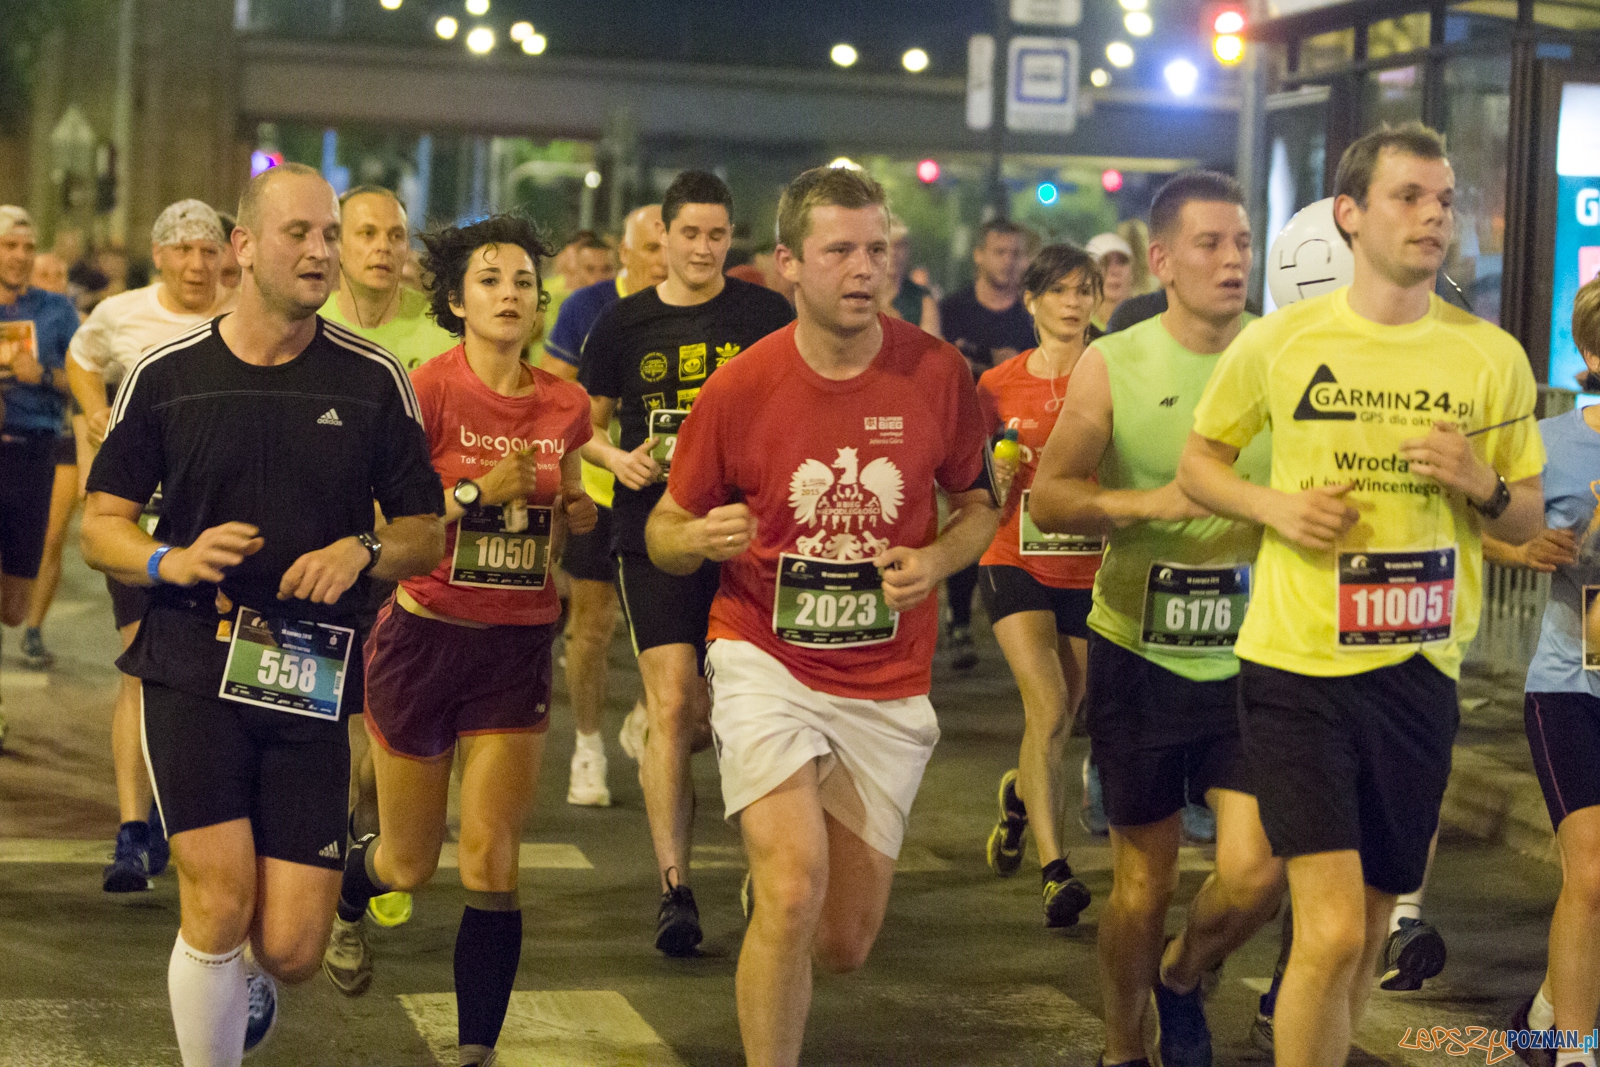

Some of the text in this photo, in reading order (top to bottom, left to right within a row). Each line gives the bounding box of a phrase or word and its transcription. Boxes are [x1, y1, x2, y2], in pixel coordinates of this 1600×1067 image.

[1576, 188, 1600, 227] G
[1314, 387, 1475, 418] GARMIN24.pl
[1359, 410, 1385, 424] GPS
[316, 417, 343, 427] adidas
[878, 421, 904, 430] BIEG
[460, 455, 476, 465] Tak
[480, 458, 497, 467] spot
[1334, 451, 1430, 474] Wrocła
[476, 536, 536, 569] 1050
[794, 592, 877, 628] 2023
[1165, 597, 1232, 632] 6176
[1351, 585, 1444, 627] 11005
[257, 649, 318, 693] 558
